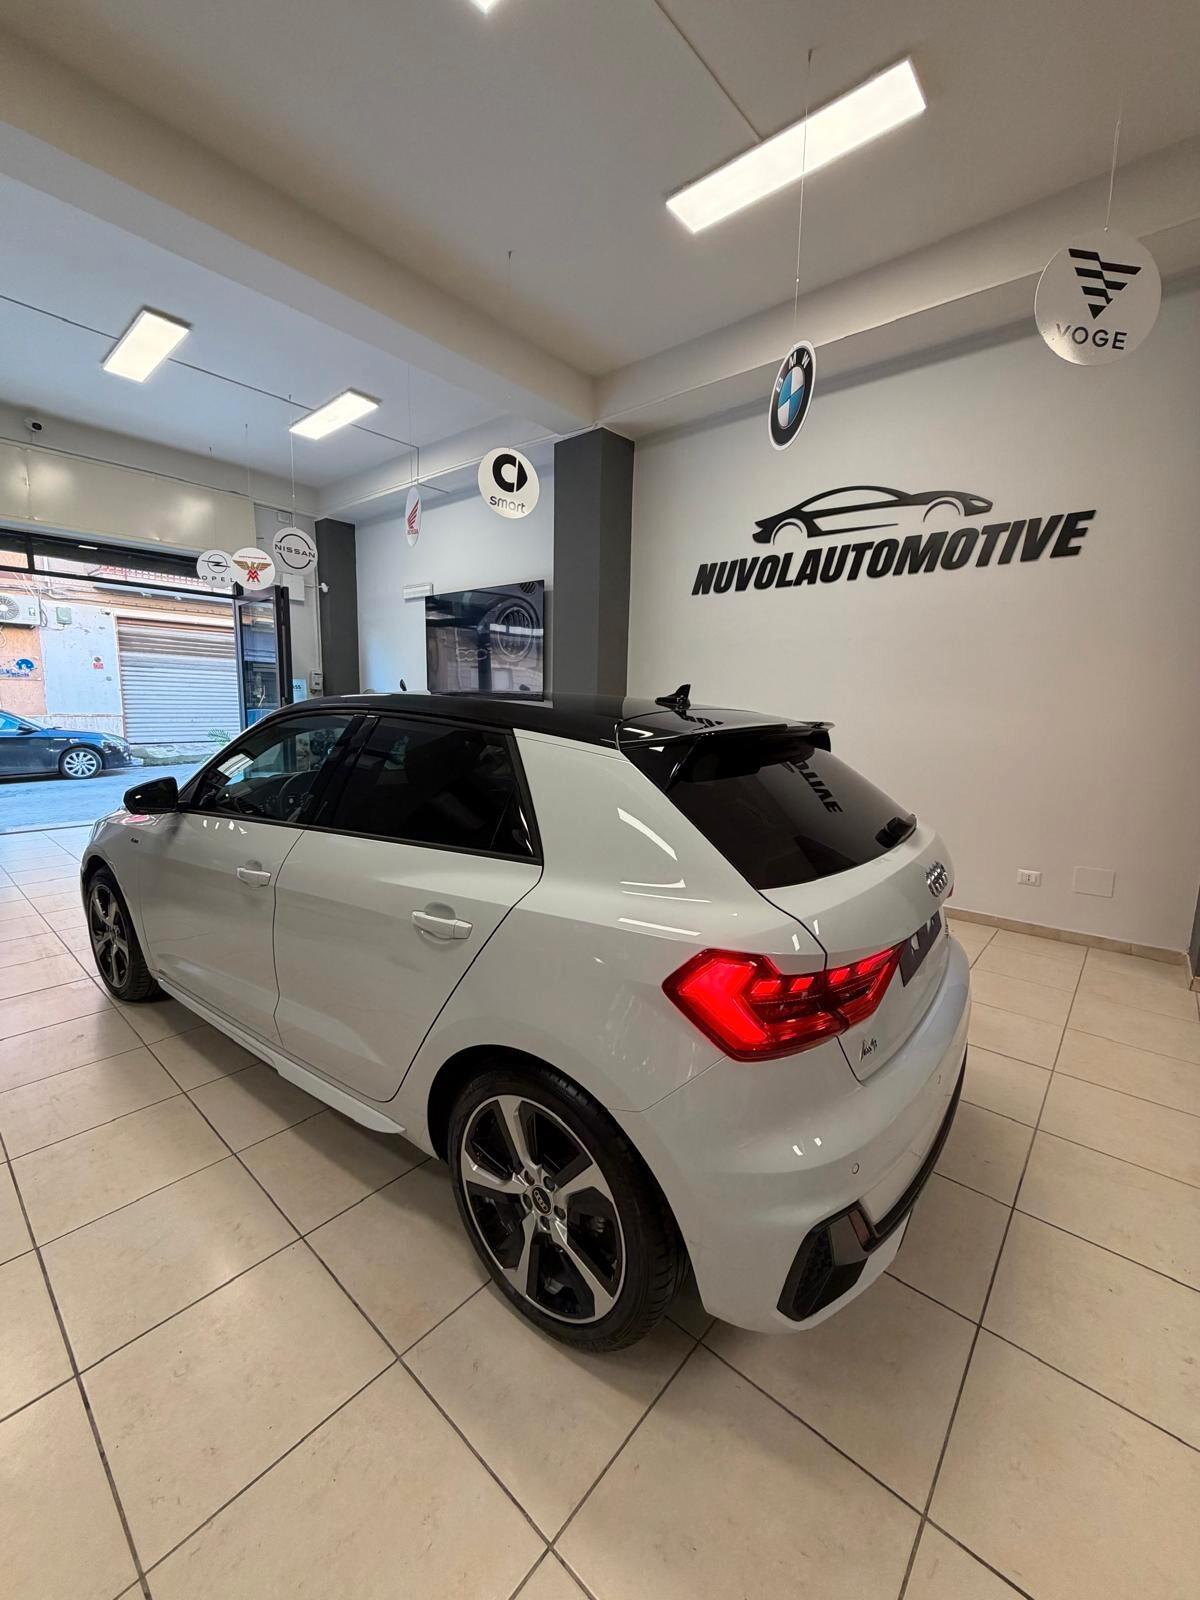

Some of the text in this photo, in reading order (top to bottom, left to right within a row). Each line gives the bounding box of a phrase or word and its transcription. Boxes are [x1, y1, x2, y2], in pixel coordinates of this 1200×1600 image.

[1055, 323, 1128, 350] VOGE
[776, 350, 811, 393] BMW
[489, 495, 526, 514] smart
[274, 543, 316, 559] NISSAN
[691, 509, 1097, 596] NUVOLAUTOMOTIVE
[201, 575, 235, 583] OPEL
